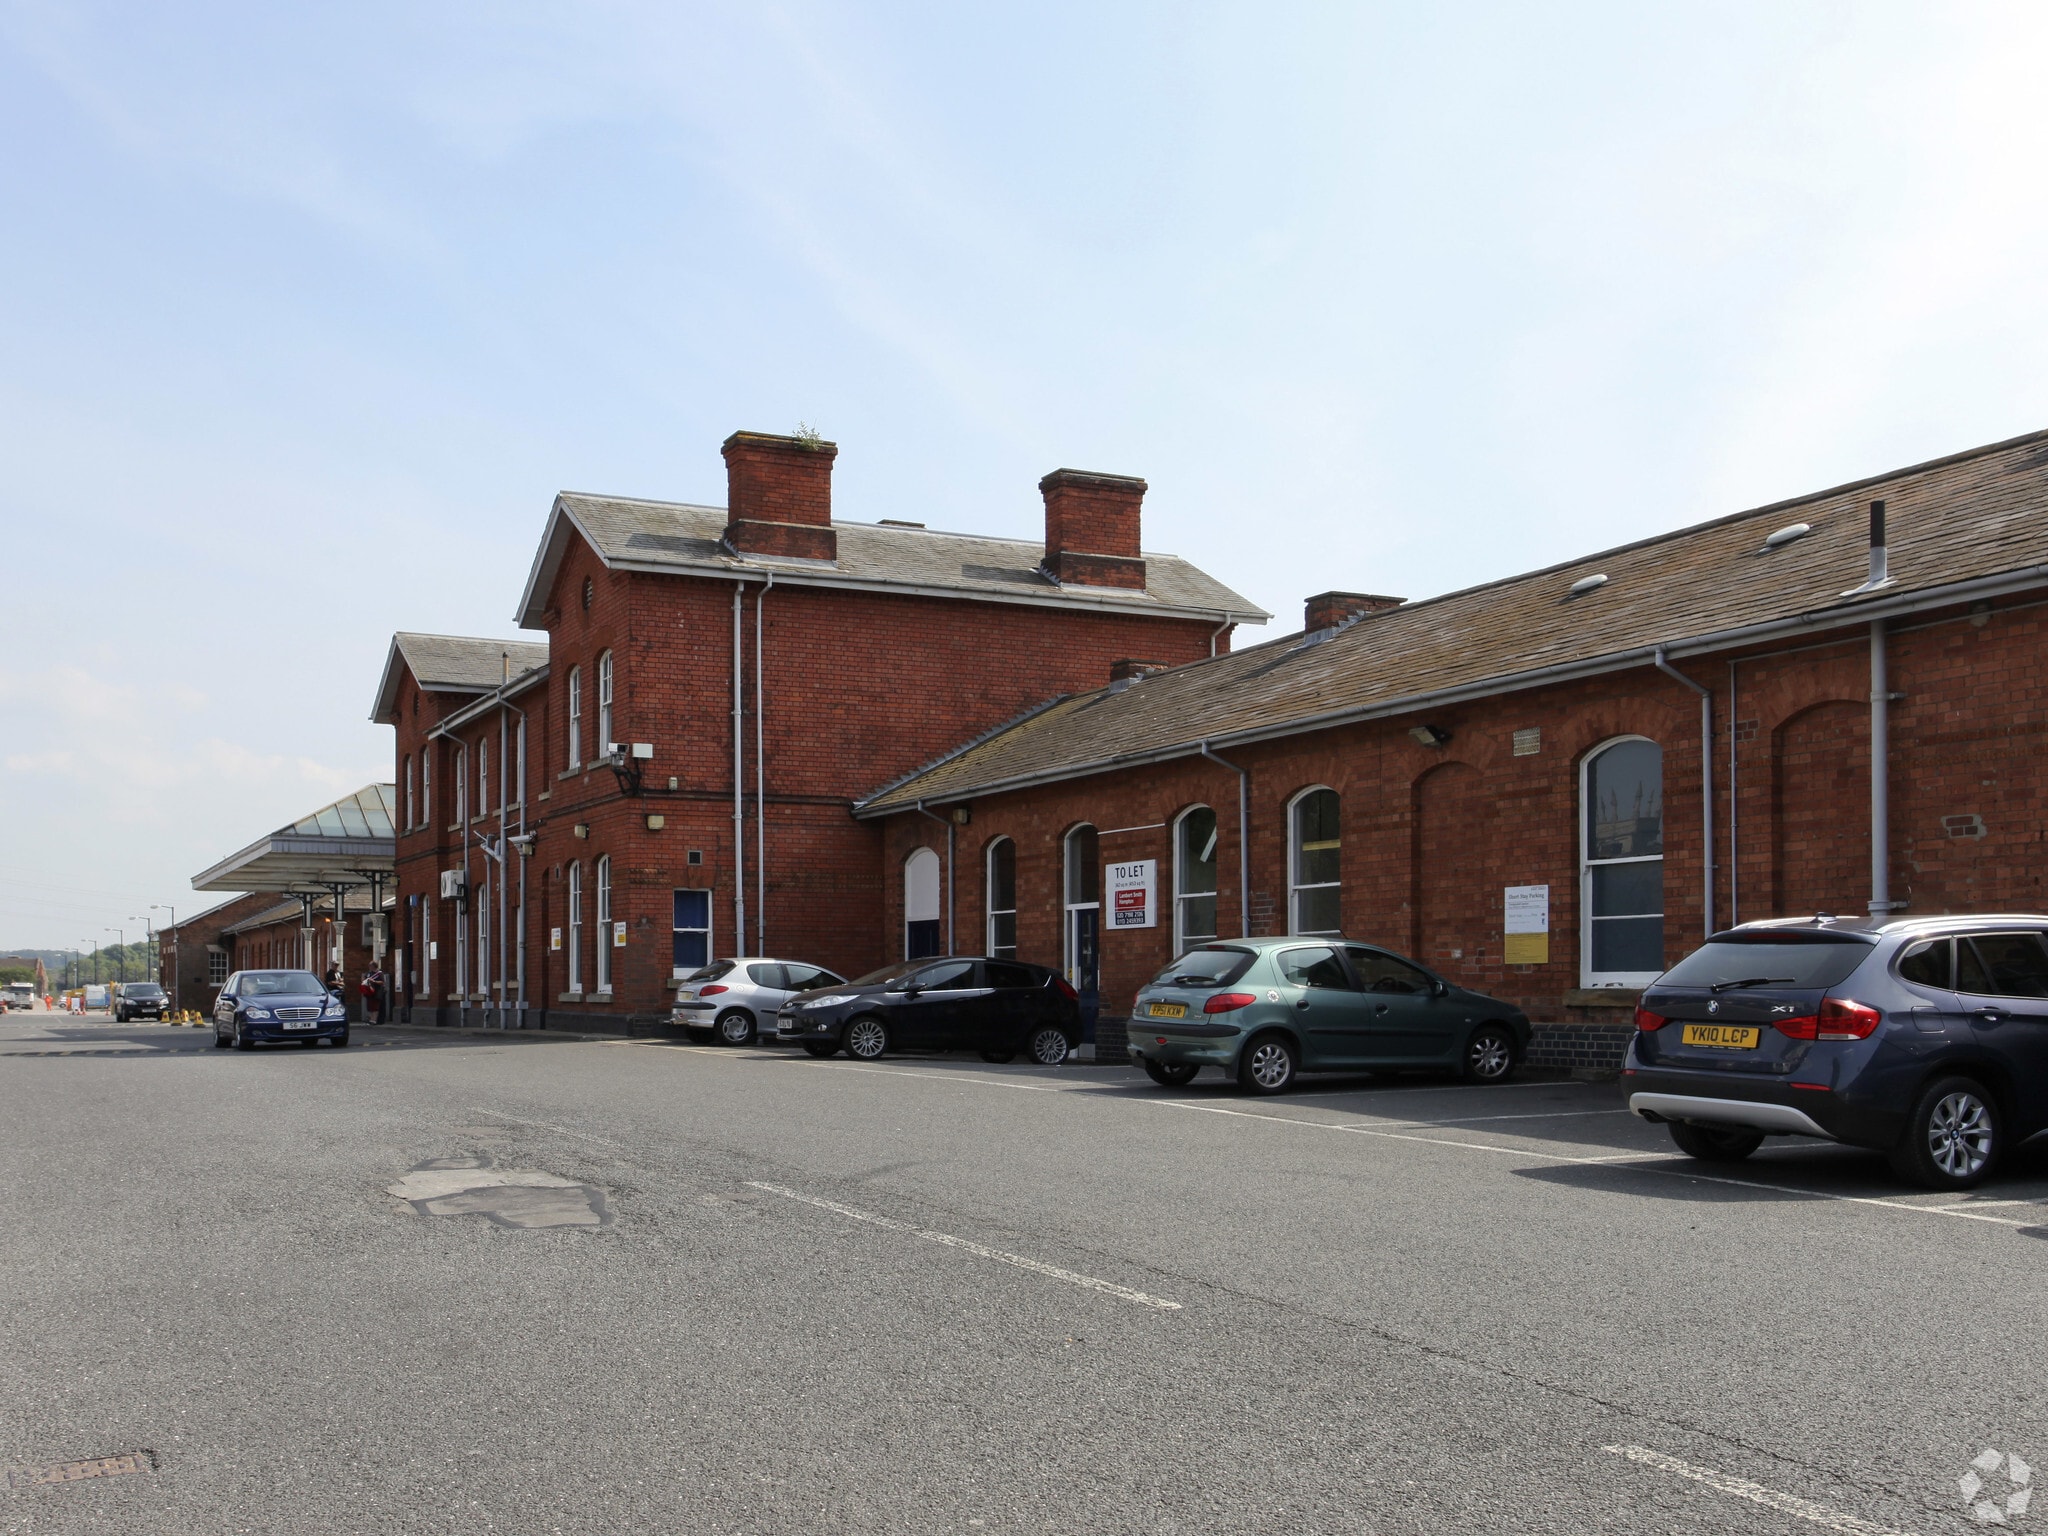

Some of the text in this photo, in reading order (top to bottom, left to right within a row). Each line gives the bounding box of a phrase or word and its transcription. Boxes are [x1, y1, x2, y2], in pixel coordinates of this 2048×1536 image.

[1115, 865, 1144, 878] TO LET
[1691, 1027, 1749, 1044] YK10 LCP
